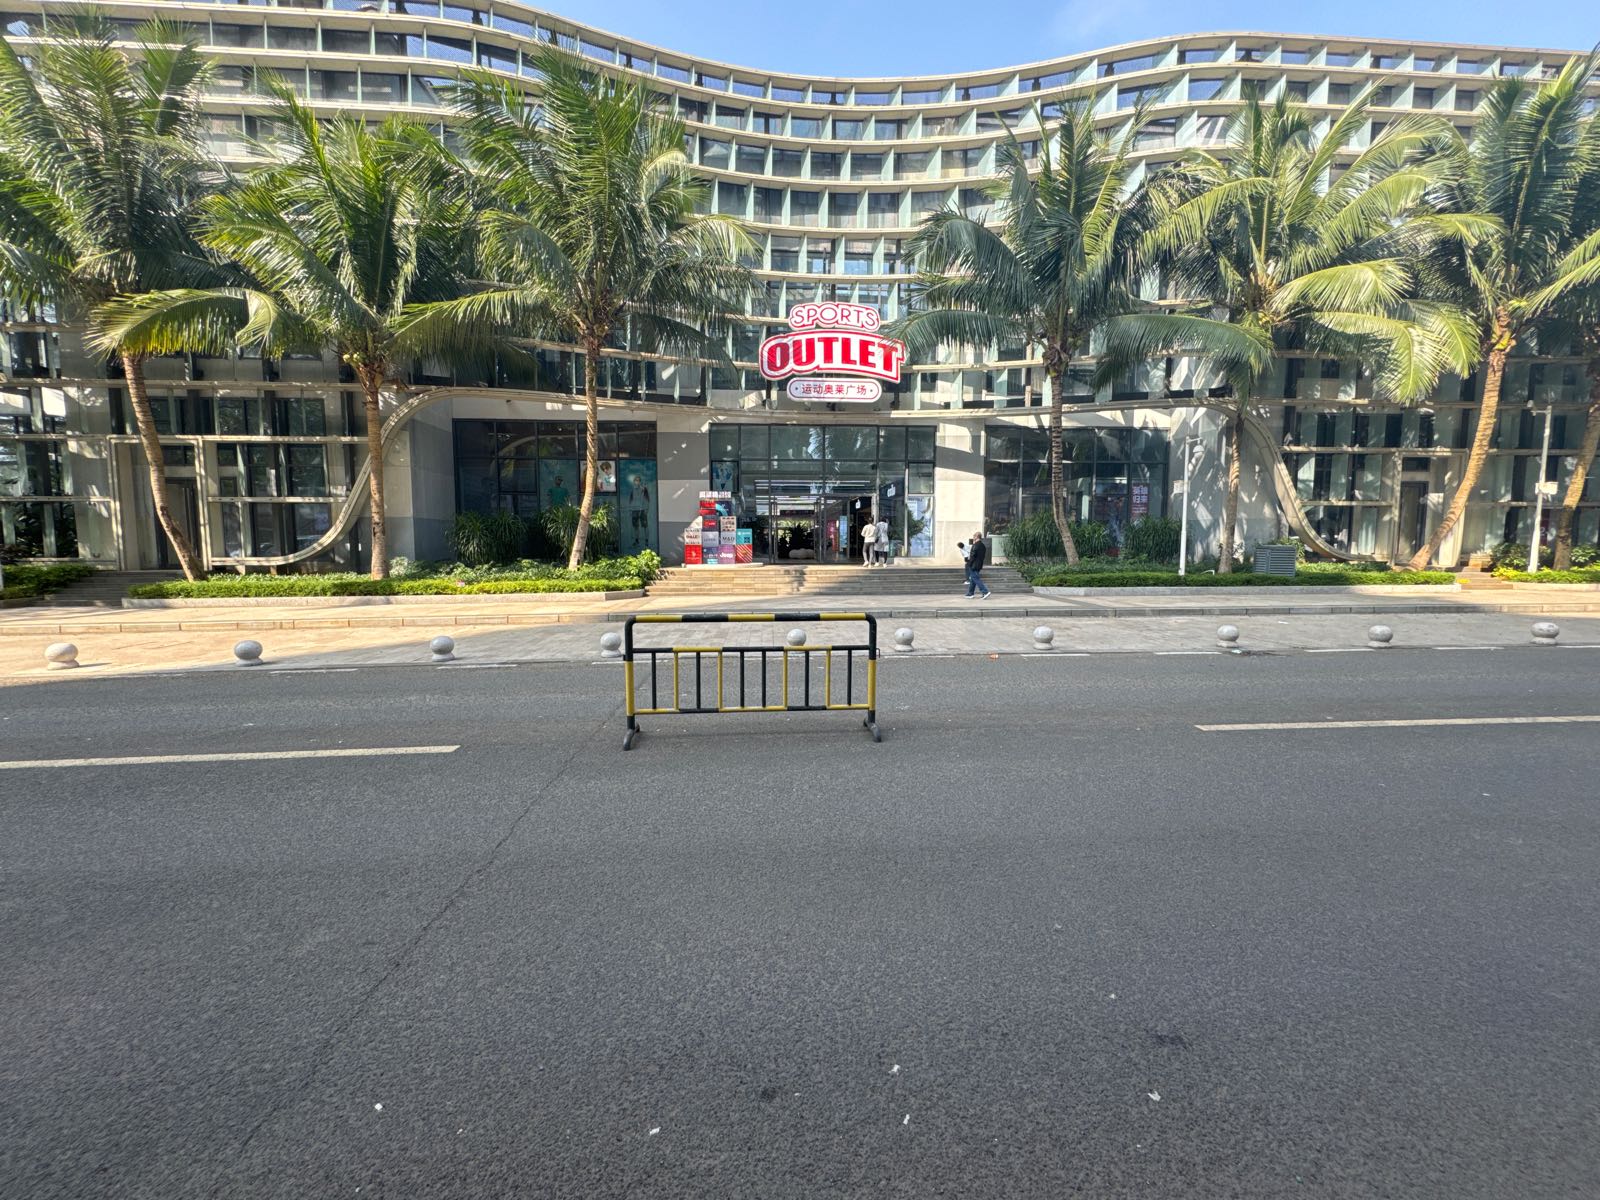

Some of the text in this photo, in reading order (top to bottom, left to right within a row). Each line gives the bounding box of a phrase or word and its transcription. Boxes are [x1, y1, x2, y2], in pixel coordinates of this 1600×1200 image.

[794, 306, 876, 327] SPORTS
[767, 336, 898, 373] OUTLET
[801, 383, 867, 396] 运动奥莱广场
